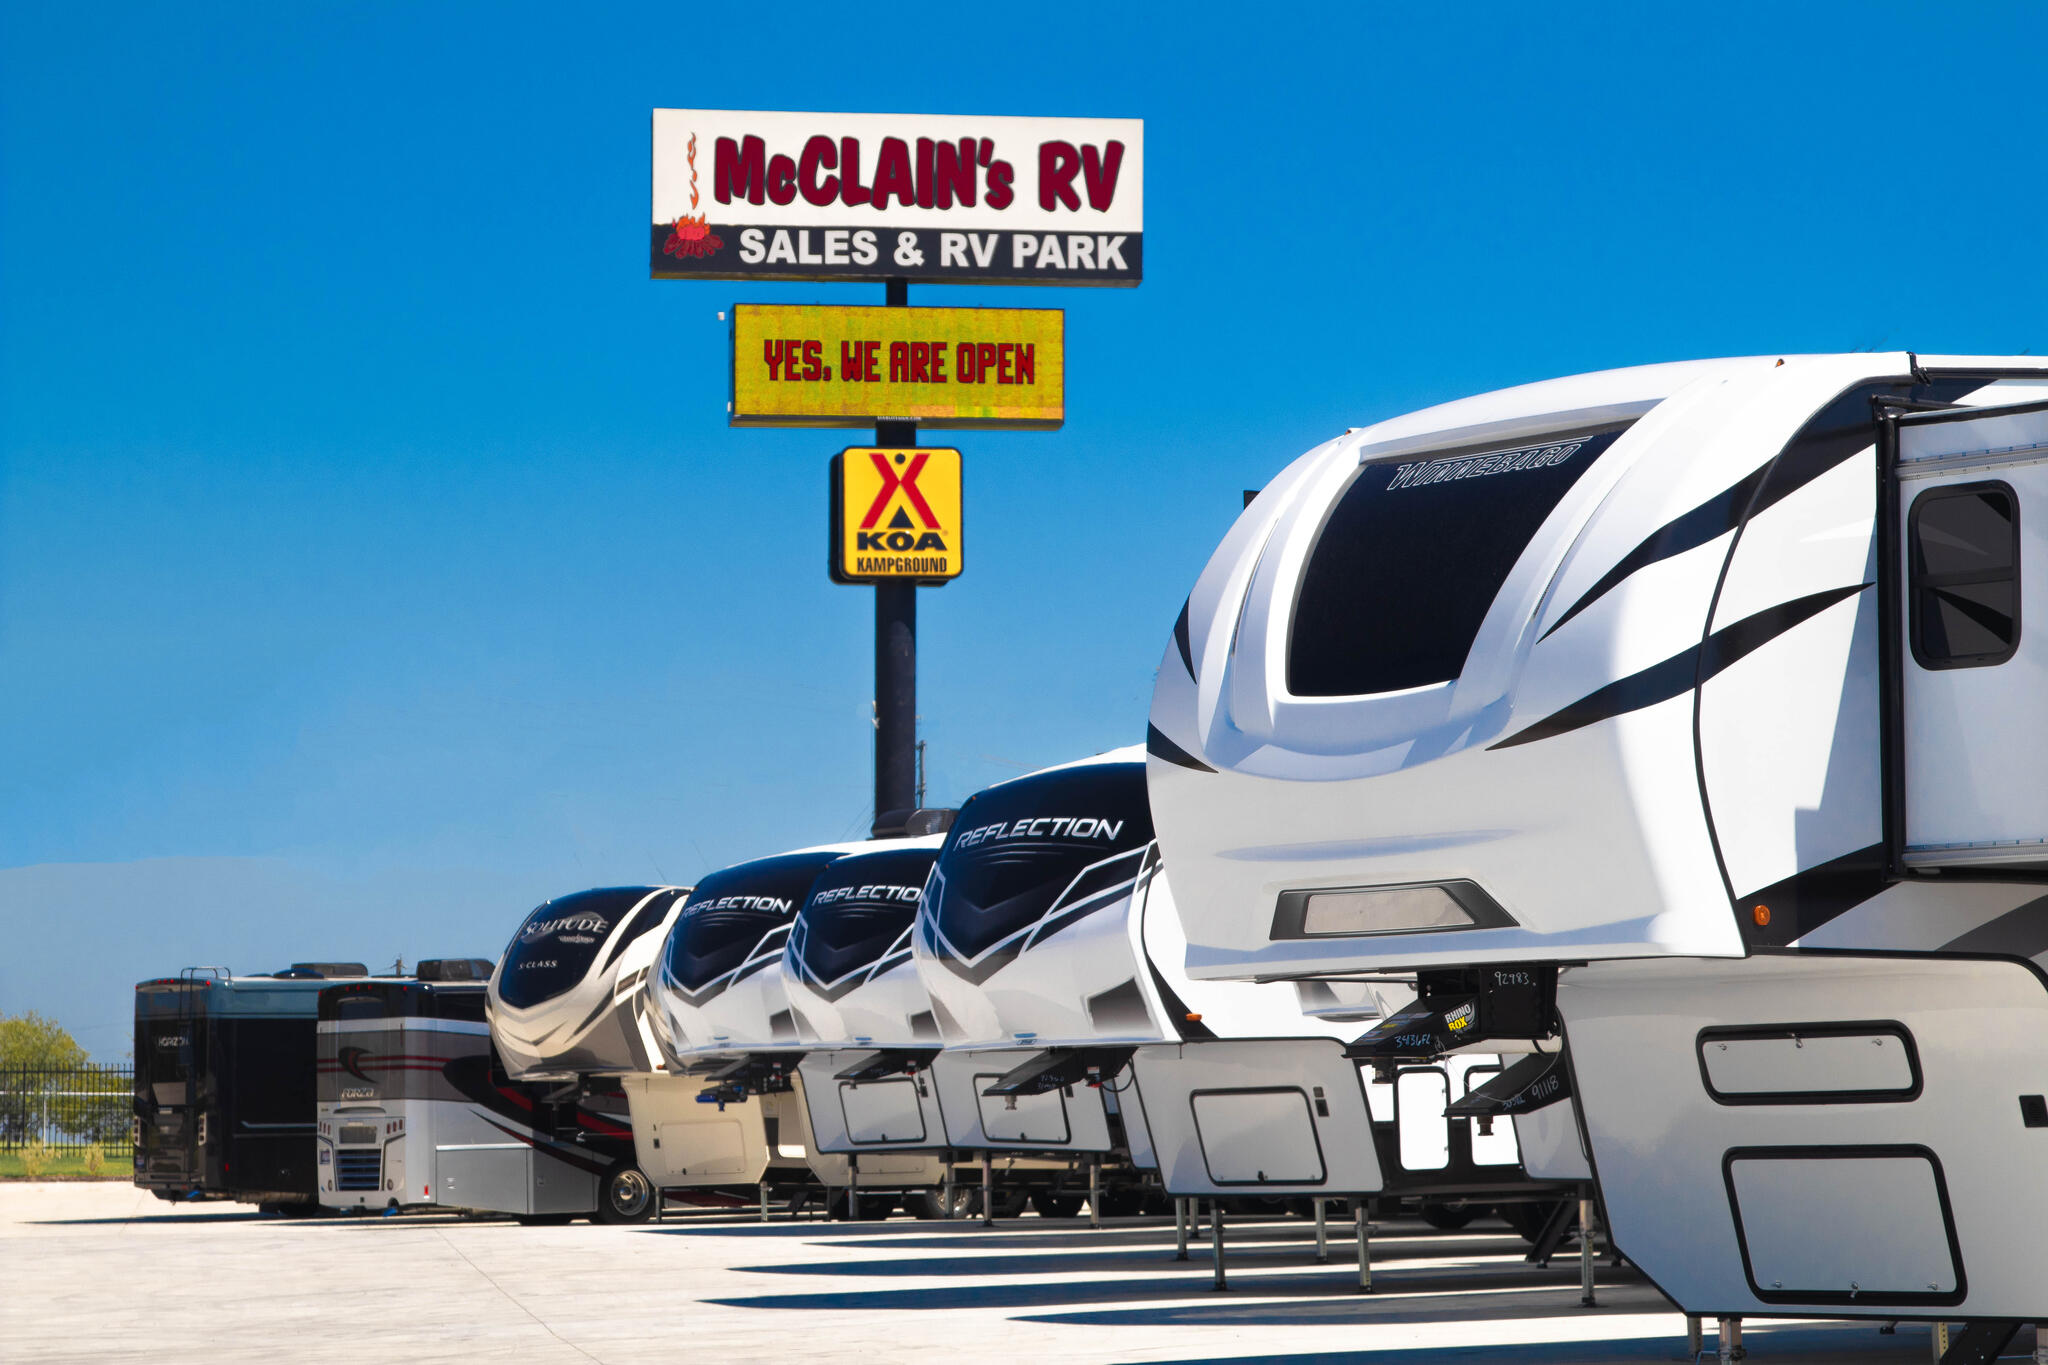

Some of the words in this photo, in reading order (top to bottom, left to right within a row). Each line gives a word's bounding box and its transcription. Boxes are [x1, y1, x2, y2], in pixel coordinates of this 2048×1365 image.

[714, 134, 1014, 210] McCLAIN's
[1038, 140, 1124, 212] RV
[739, 228, 878, 265] SALES
[893, 232, 925, 267] &
[940, 234, 998, 268] RV
[1012, 235, 1128, 270] PARK
[764, 339, 831, 381] YES,
[841, 340, 881, 382] WE
[889, 341, 947, 383] ARE
[957, 343, 1035, 384] OPEN
[1387, 442, 1583, 491] WINNEBAGO
[857, 531, 948, 551] KOA
[857, 557, 948, 573] KAMPGROUND
[953, 818, 1123, 851] REFLECTION
[812, 885, 923, 906] REFLECTIO
[681, 896, 793, 919] REFLECTION
[526, 918, 609, 934] SOLITUDE
[1445, 1003, 1472, 1024] RHINO
